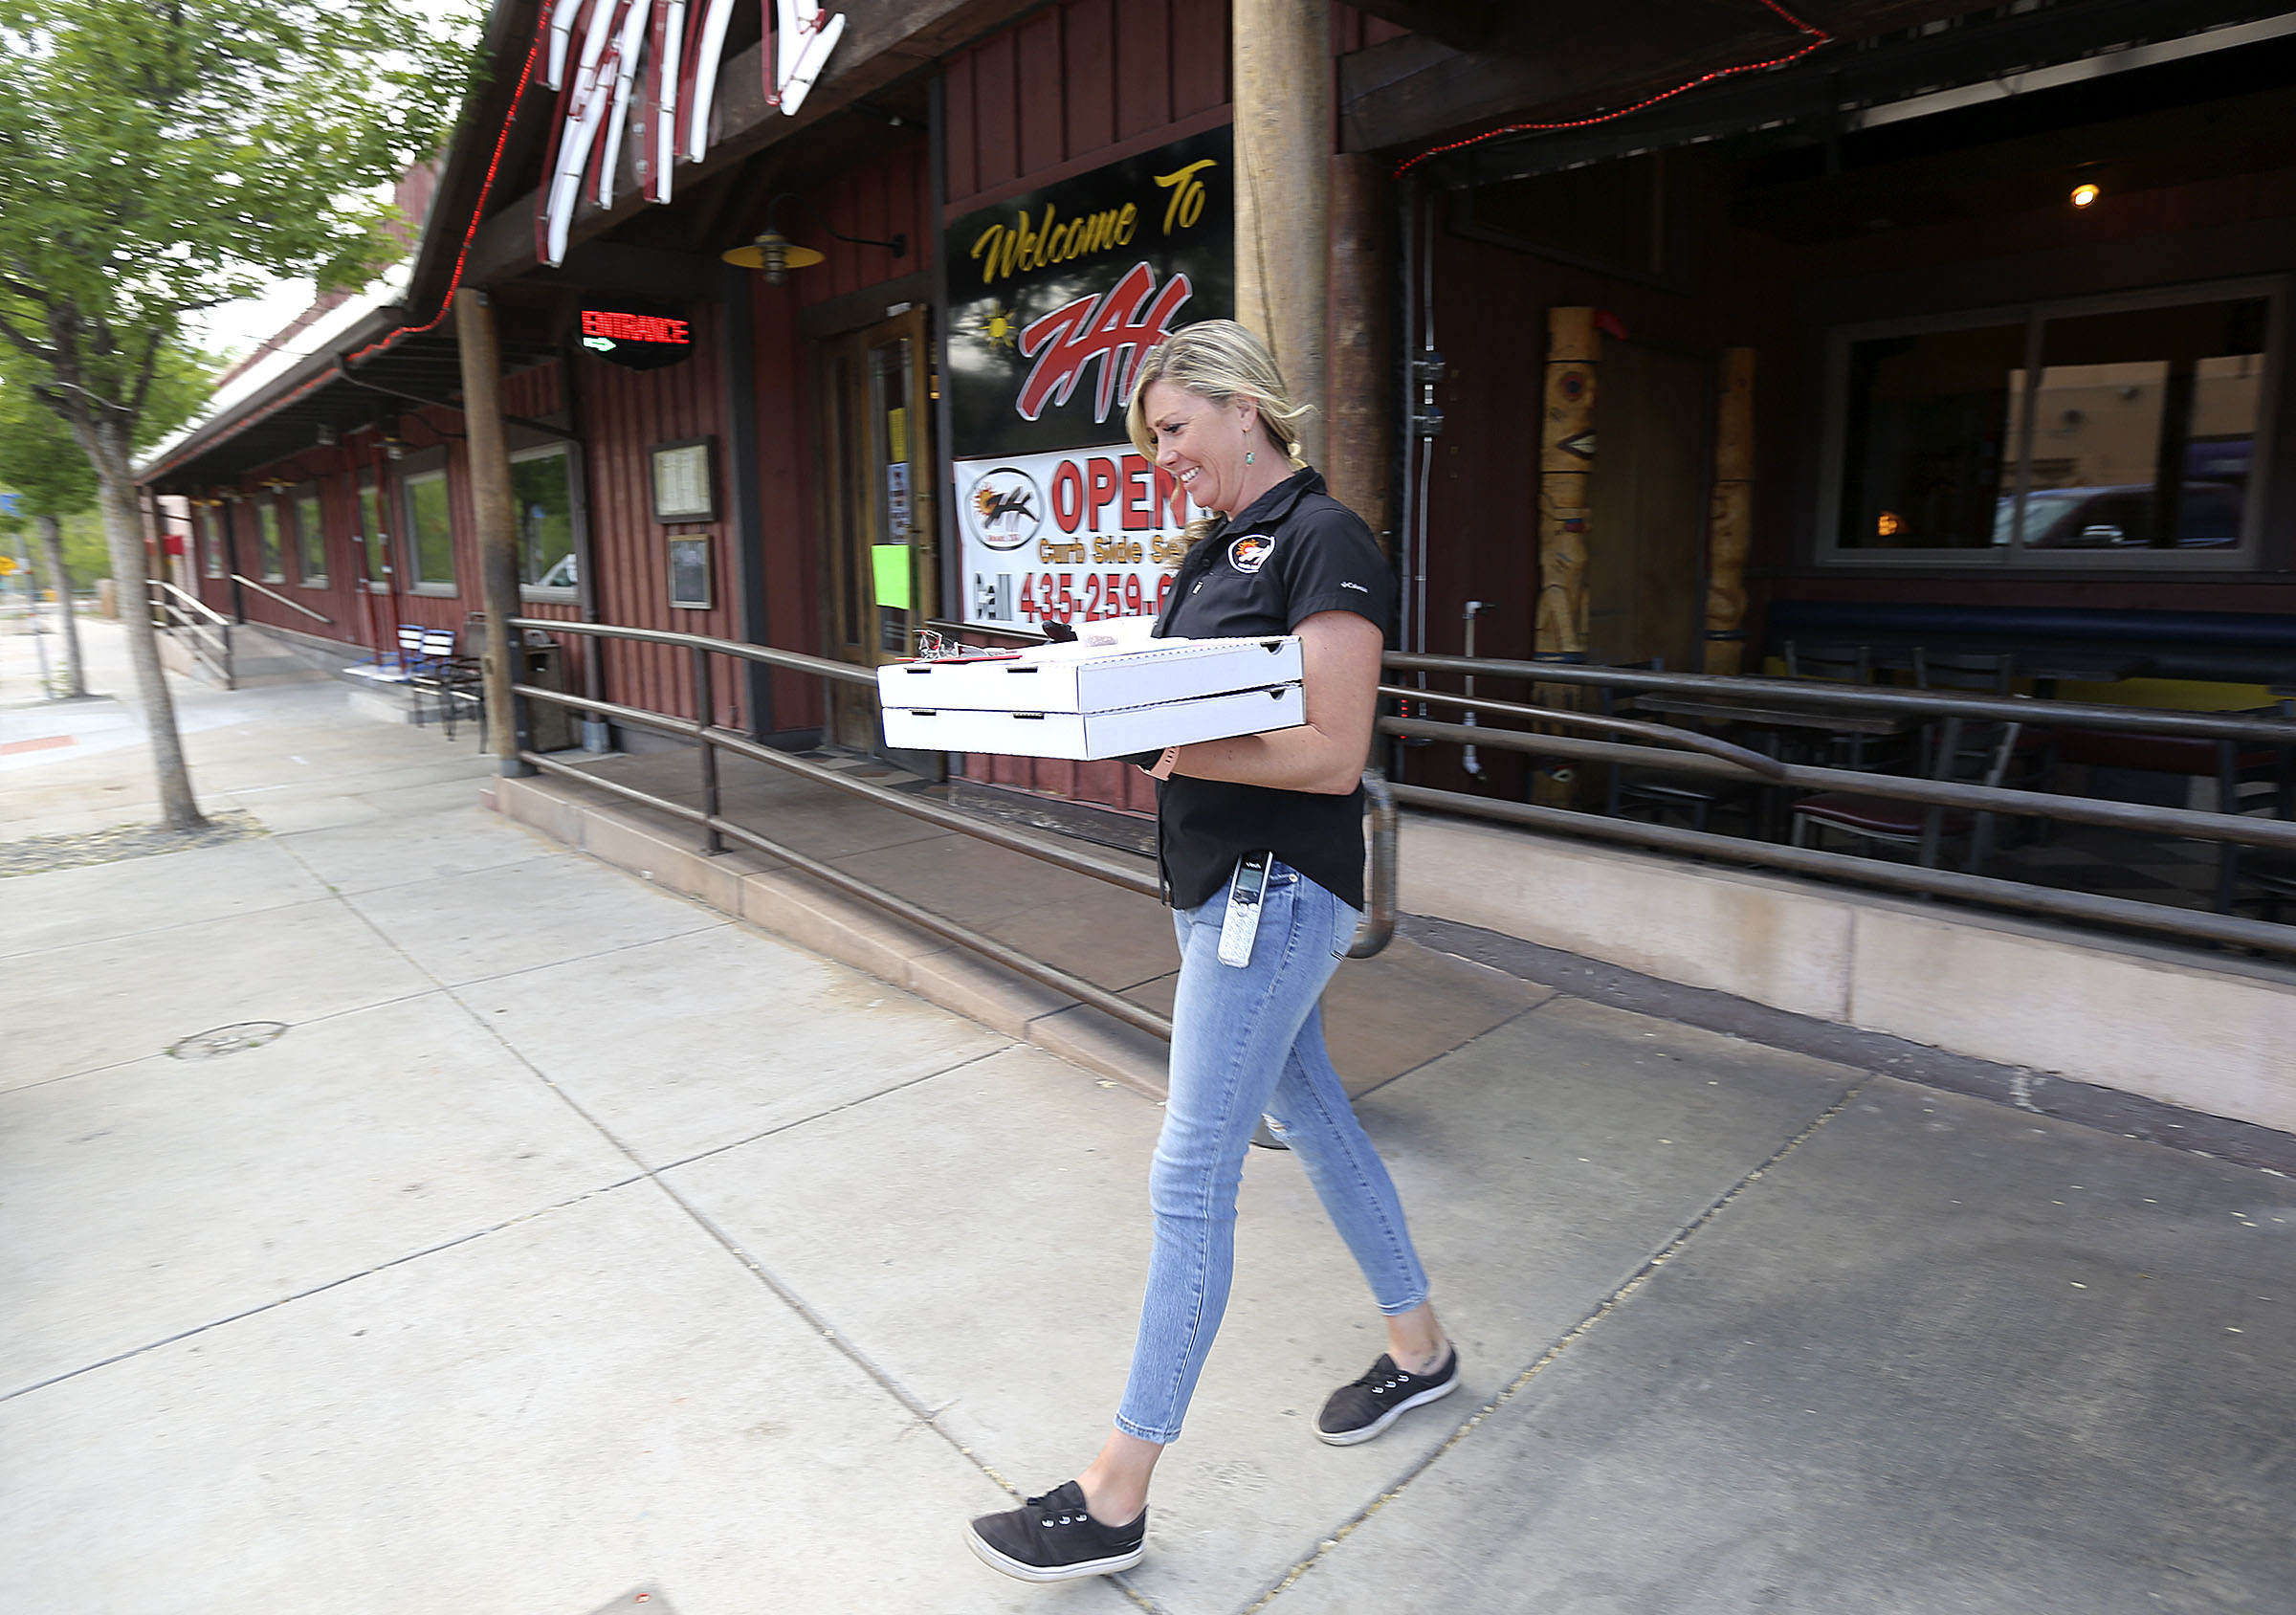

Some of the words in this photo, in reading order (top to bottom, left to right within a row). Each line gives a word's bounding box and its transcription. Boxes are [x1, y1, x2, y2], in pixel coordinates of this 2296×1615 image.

[971, 202, 1137, 284] Welcome
[1154, 159, 1218, 235] To
[582, 311, 690, 344] ENTRANCE
[1051, 454, 1187, 533] OPEN
[1039, 538, 1086, 564] Curb
[1093, 536, 1142, 564] Side
[974, 573, 1012, 621] Call
